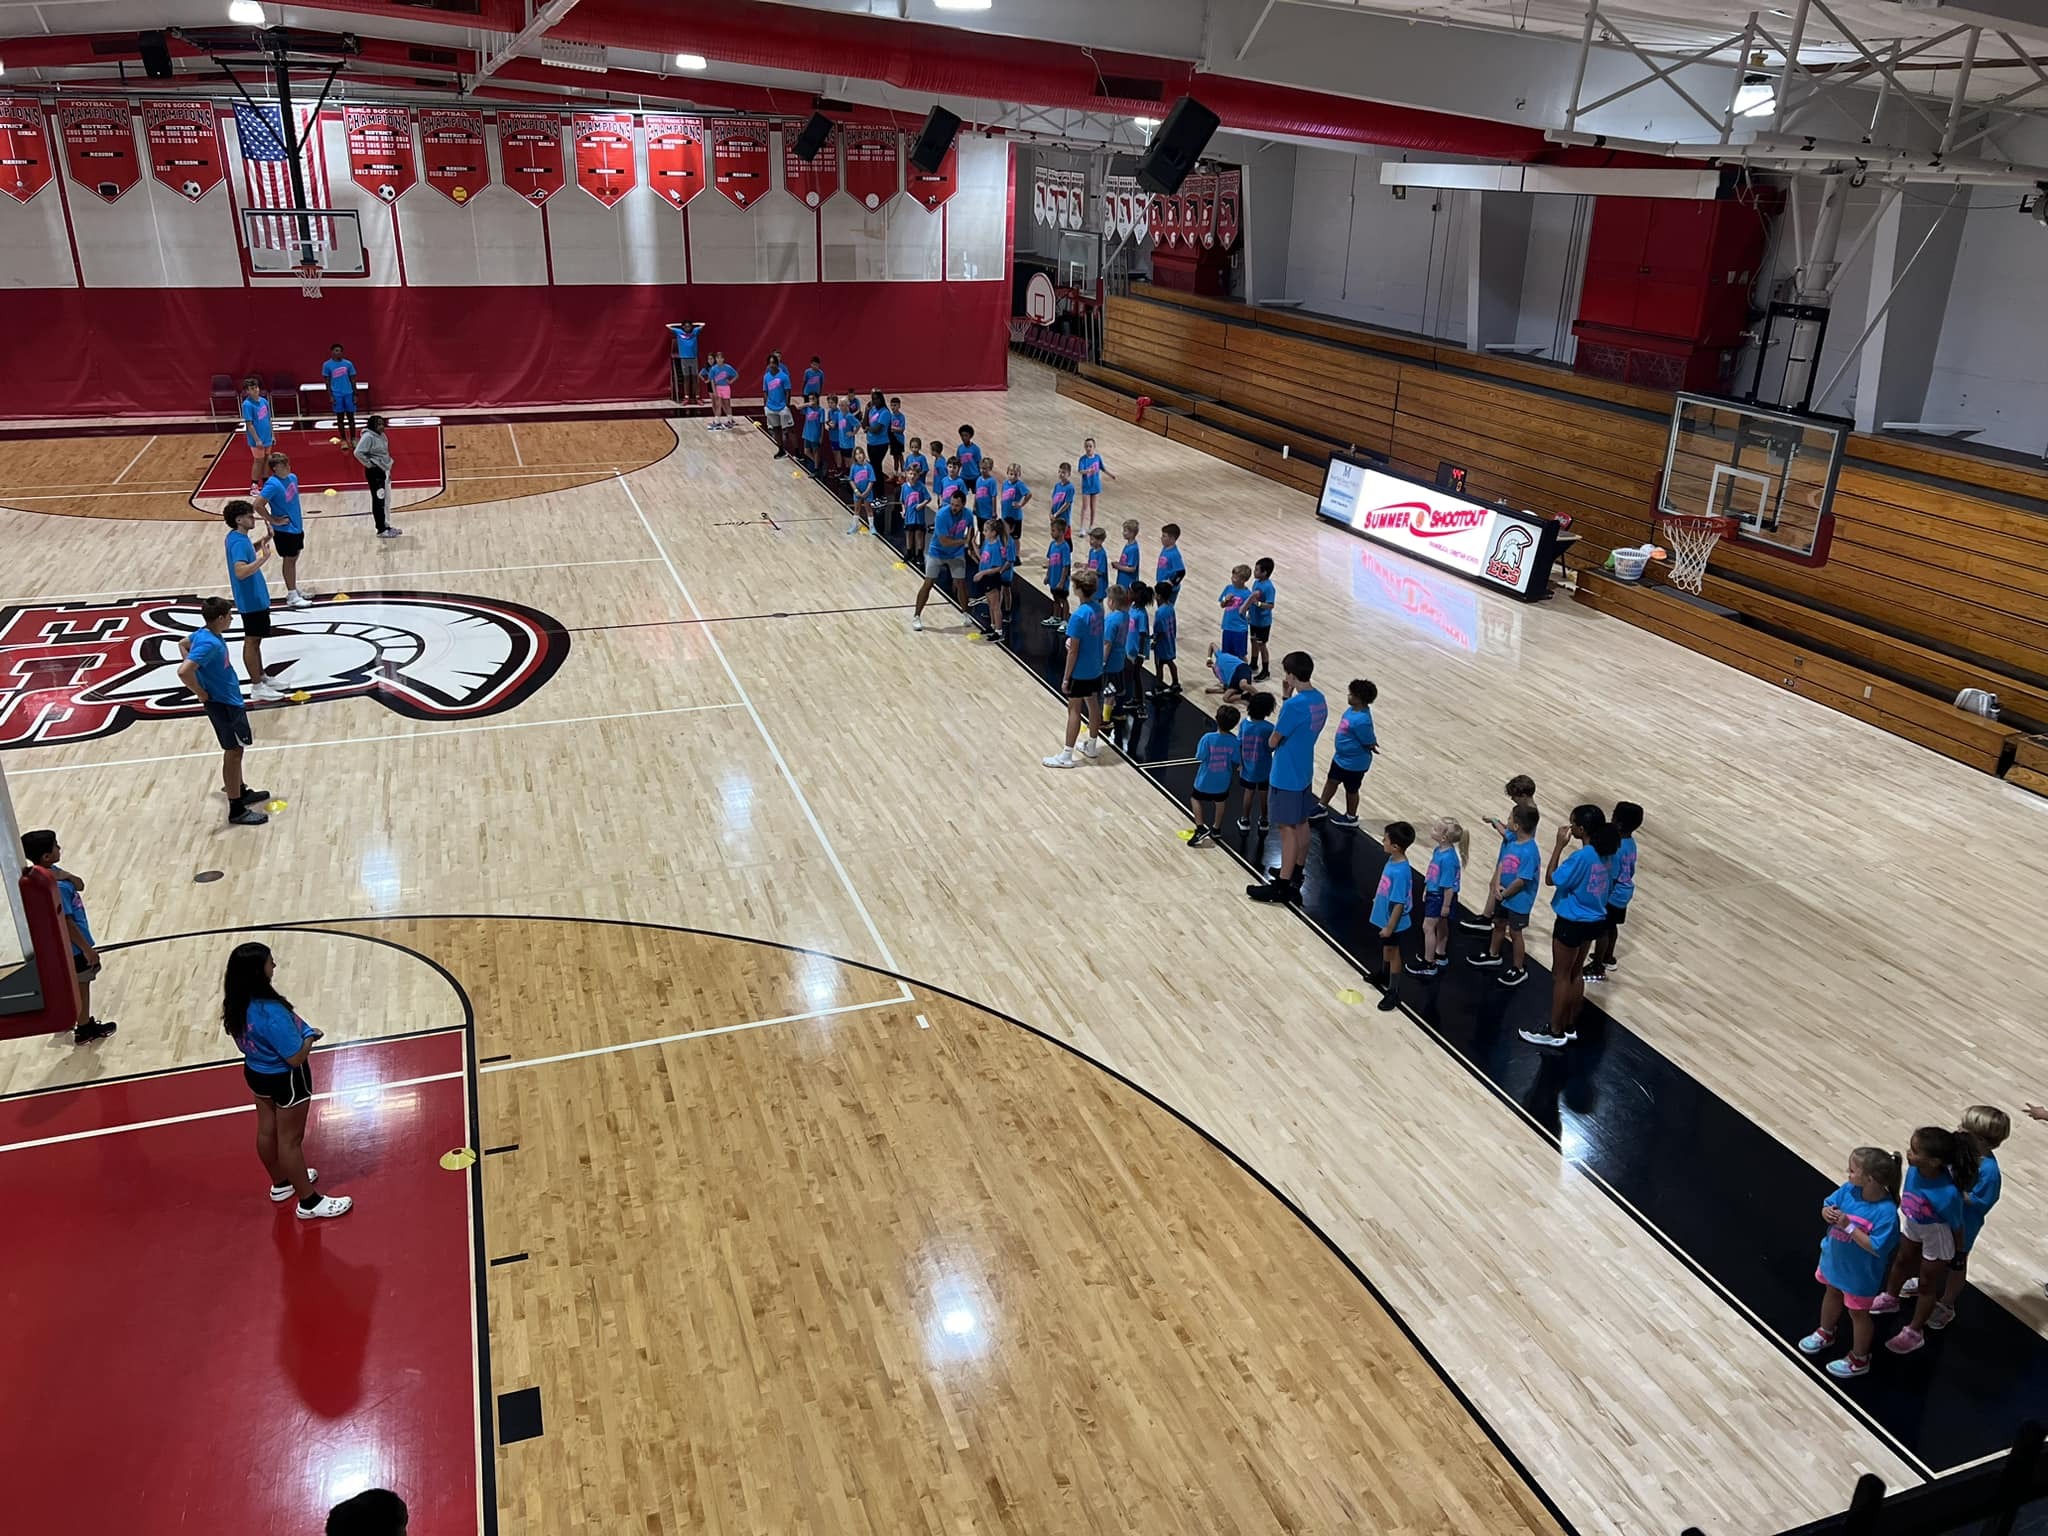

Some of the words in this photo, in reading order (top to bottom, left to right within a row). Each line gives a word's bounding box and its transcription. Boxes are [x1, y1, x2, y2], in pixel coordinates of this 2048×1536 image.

[62, 107, 130, 129] CHAMPIONS
[145, 108, 213, 130] CHAMPIONS
[346, 114, 410, 135] CHAMPIONS
[422, 117, 483, 138] CHAMPIONS
[500, 119, 560, 139] CHAMPIONS
[575, 121, 633, 142] CHAMPIONS
[646, 124, 703, 145] CHAMPIONS
[712, 126, 767, 145] CHAMPIONS
[1364, 511, 1411, 530] SUMMER
[1430, 509, 1488, 529] SHOOTOUT
[1487, 560, 1521, 585] ECS
